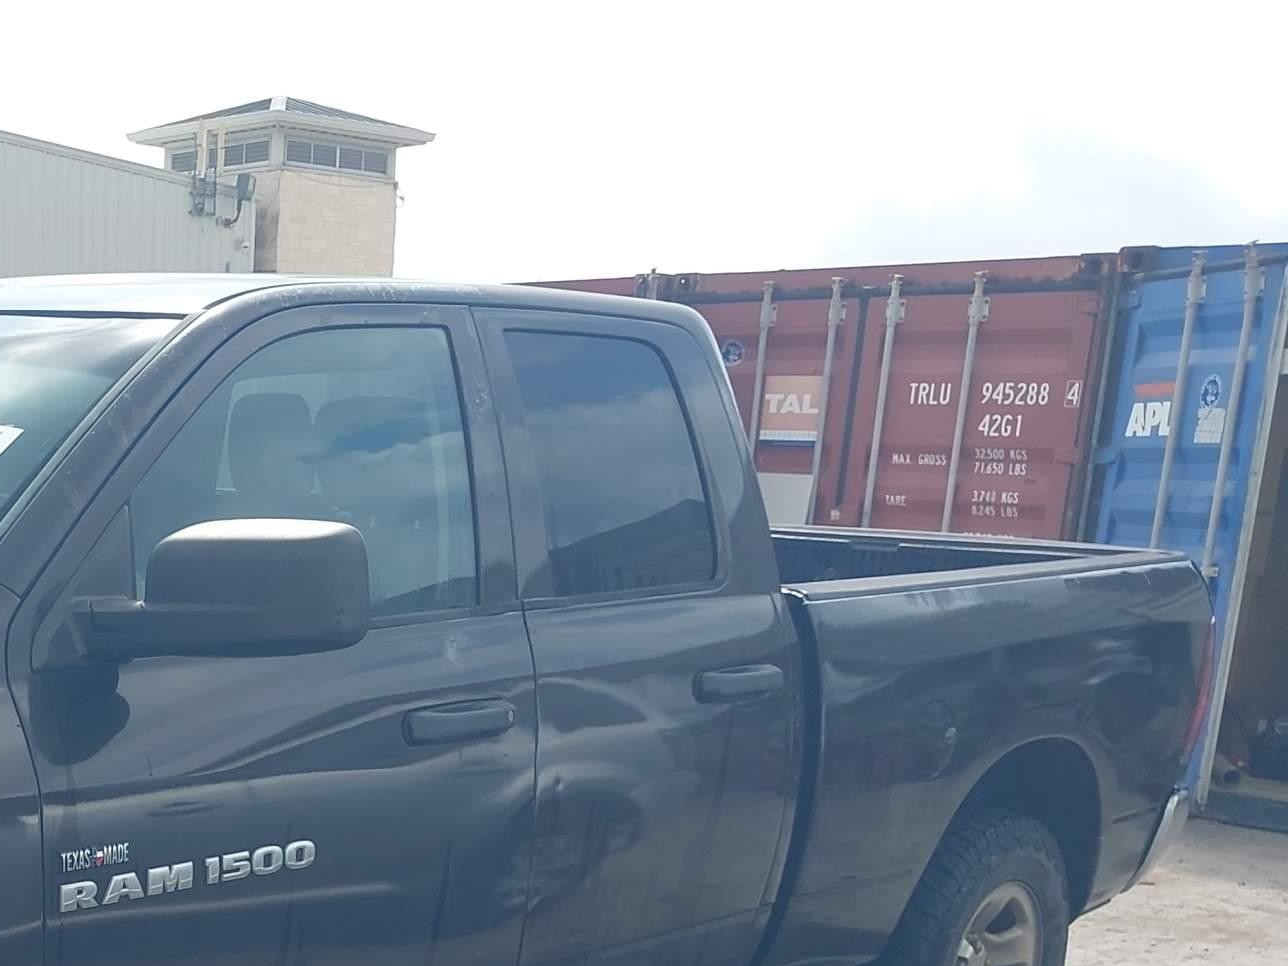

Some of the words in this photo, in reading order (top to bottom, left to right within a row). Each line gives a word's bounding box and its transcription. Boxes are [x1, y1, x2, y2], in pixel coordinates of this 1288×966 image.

[765, 393, 819, 414] TAL
[909, 382, 952, 405] TRLU
[981, 382, 1050, 405] 945288
[1066, 382, 1080, 406] 4
[978, 414, 1022, 437] 42G1
[1125, 400, 1172, 437] APL
[918, 453, 947, 466] GROSS
[1009, 449, 1028, 461] KGS
[1008, 463, 1028, 476] LBS
[885, 494, 907, 506] TARE
[1001, 491, 1019, 504] KGS
[1001, 505, 1019, 518] LBS
[61, 848, 91, 872] TEXAS
[103, 842, 130, 865] MADE
[59, 861, 194, 913] RAM
[204, 840, 316, 885] 1500
